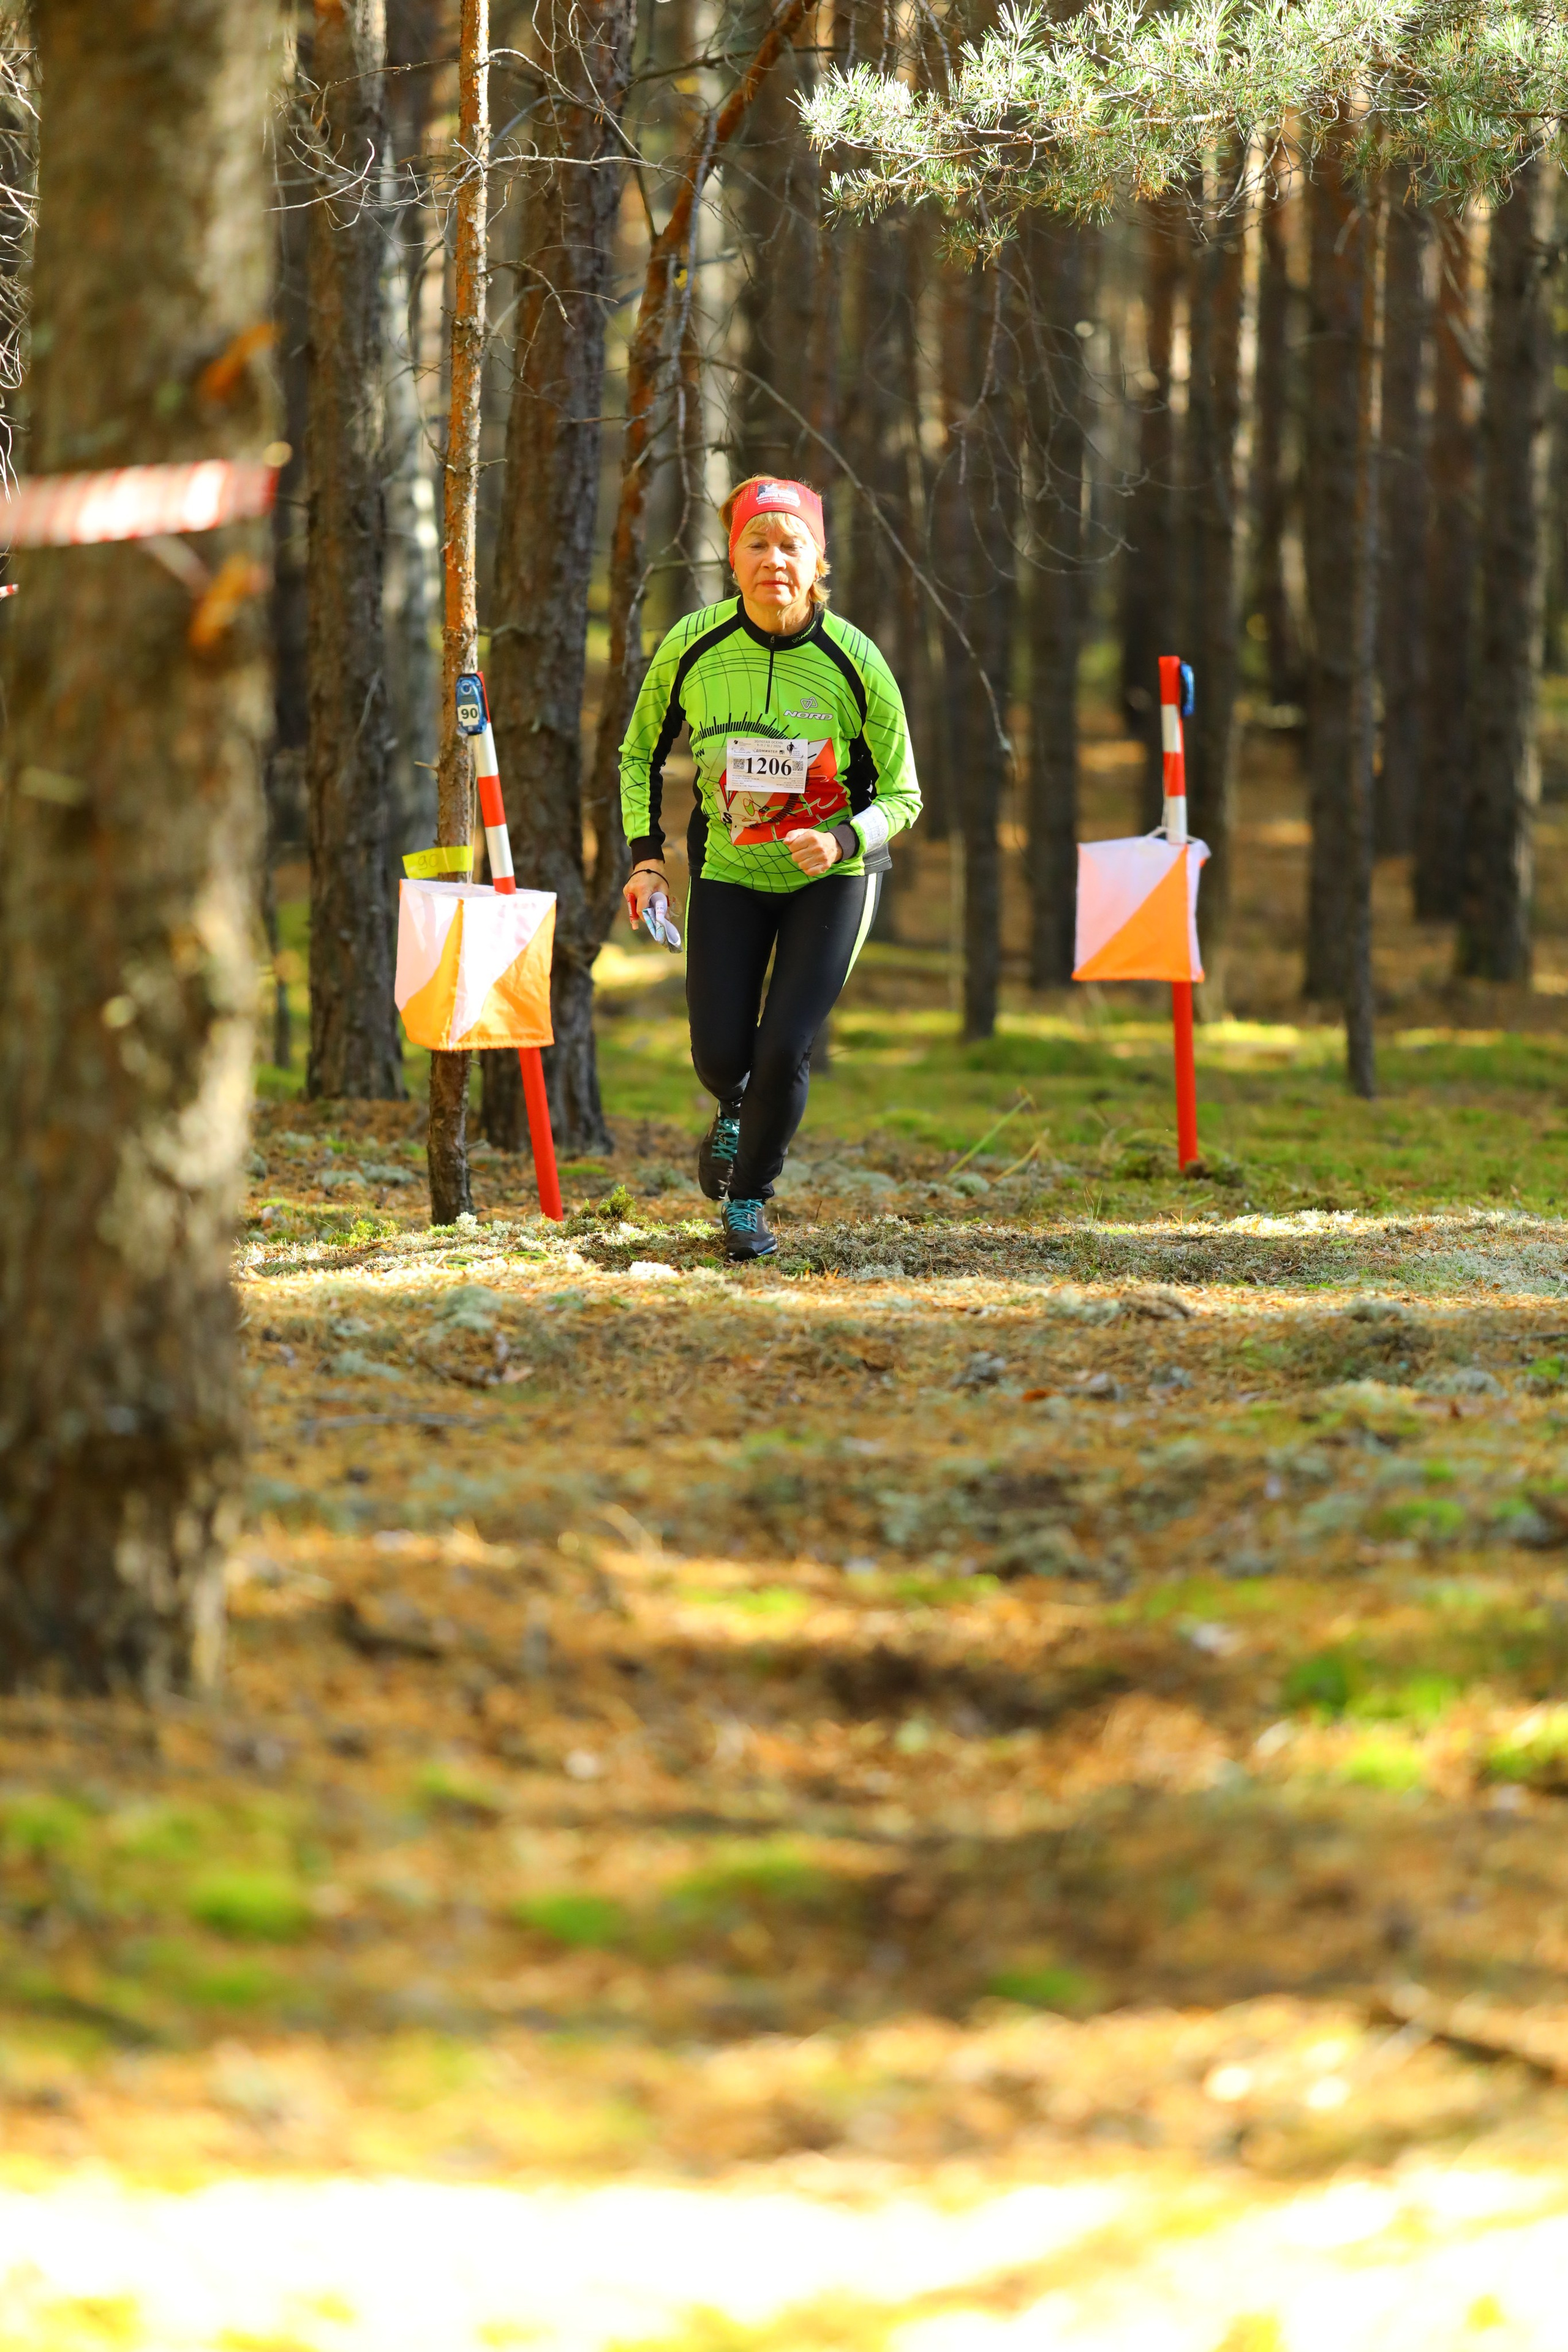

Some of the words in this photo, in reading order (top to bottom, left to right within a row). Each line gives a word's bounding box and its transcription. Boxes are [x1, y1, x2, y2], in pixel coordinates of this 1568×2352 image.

[461, 707, 478, 719] 90
[783, 709, 833, 720] NORD
[695, 748, 705, 759] NW
[745, 757, 792, 776] 1206
[722, 812, 733, 824] S
[418, 854, 438, 870] 90
